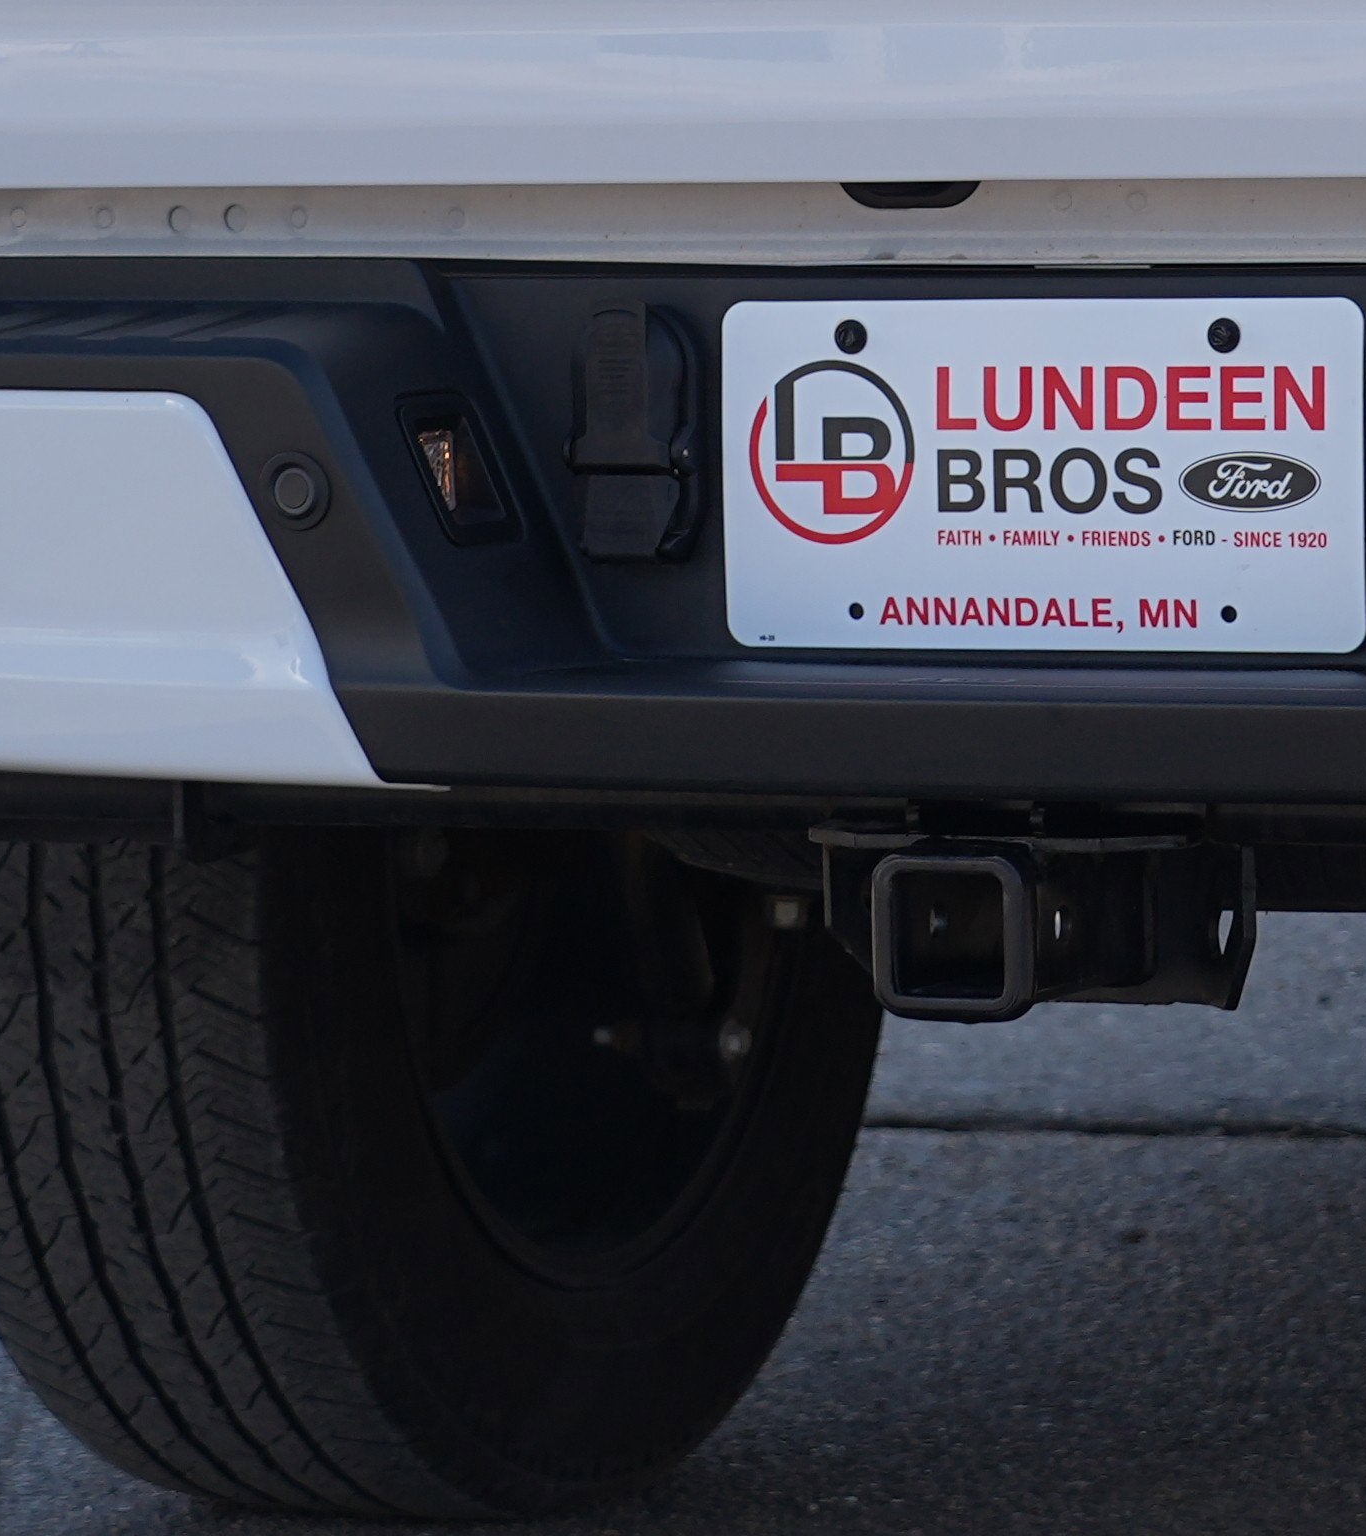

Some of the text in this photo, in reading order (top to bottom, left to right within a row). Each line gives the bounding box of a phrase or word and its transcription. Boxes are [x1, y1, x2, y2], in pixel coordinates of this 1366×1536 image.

[936, 366, 1326, 431] LUNDEEN
[936, 447, 1163, 513] BROS
[1208, 460, 1291, 500] Ford
[937, 530, 982, 546] FAITH
[1003, 530, 1060, 546] FAMILY
[1081, 530, 1151, 547] FRIENDS
[1172, 530, 1216, 546] FORD
[1233, 531, 1282, 548] SINCE
[1288, 532, 1328, 548] 1920
[879, 596, 1198, 633] ANNANDALE, MN
